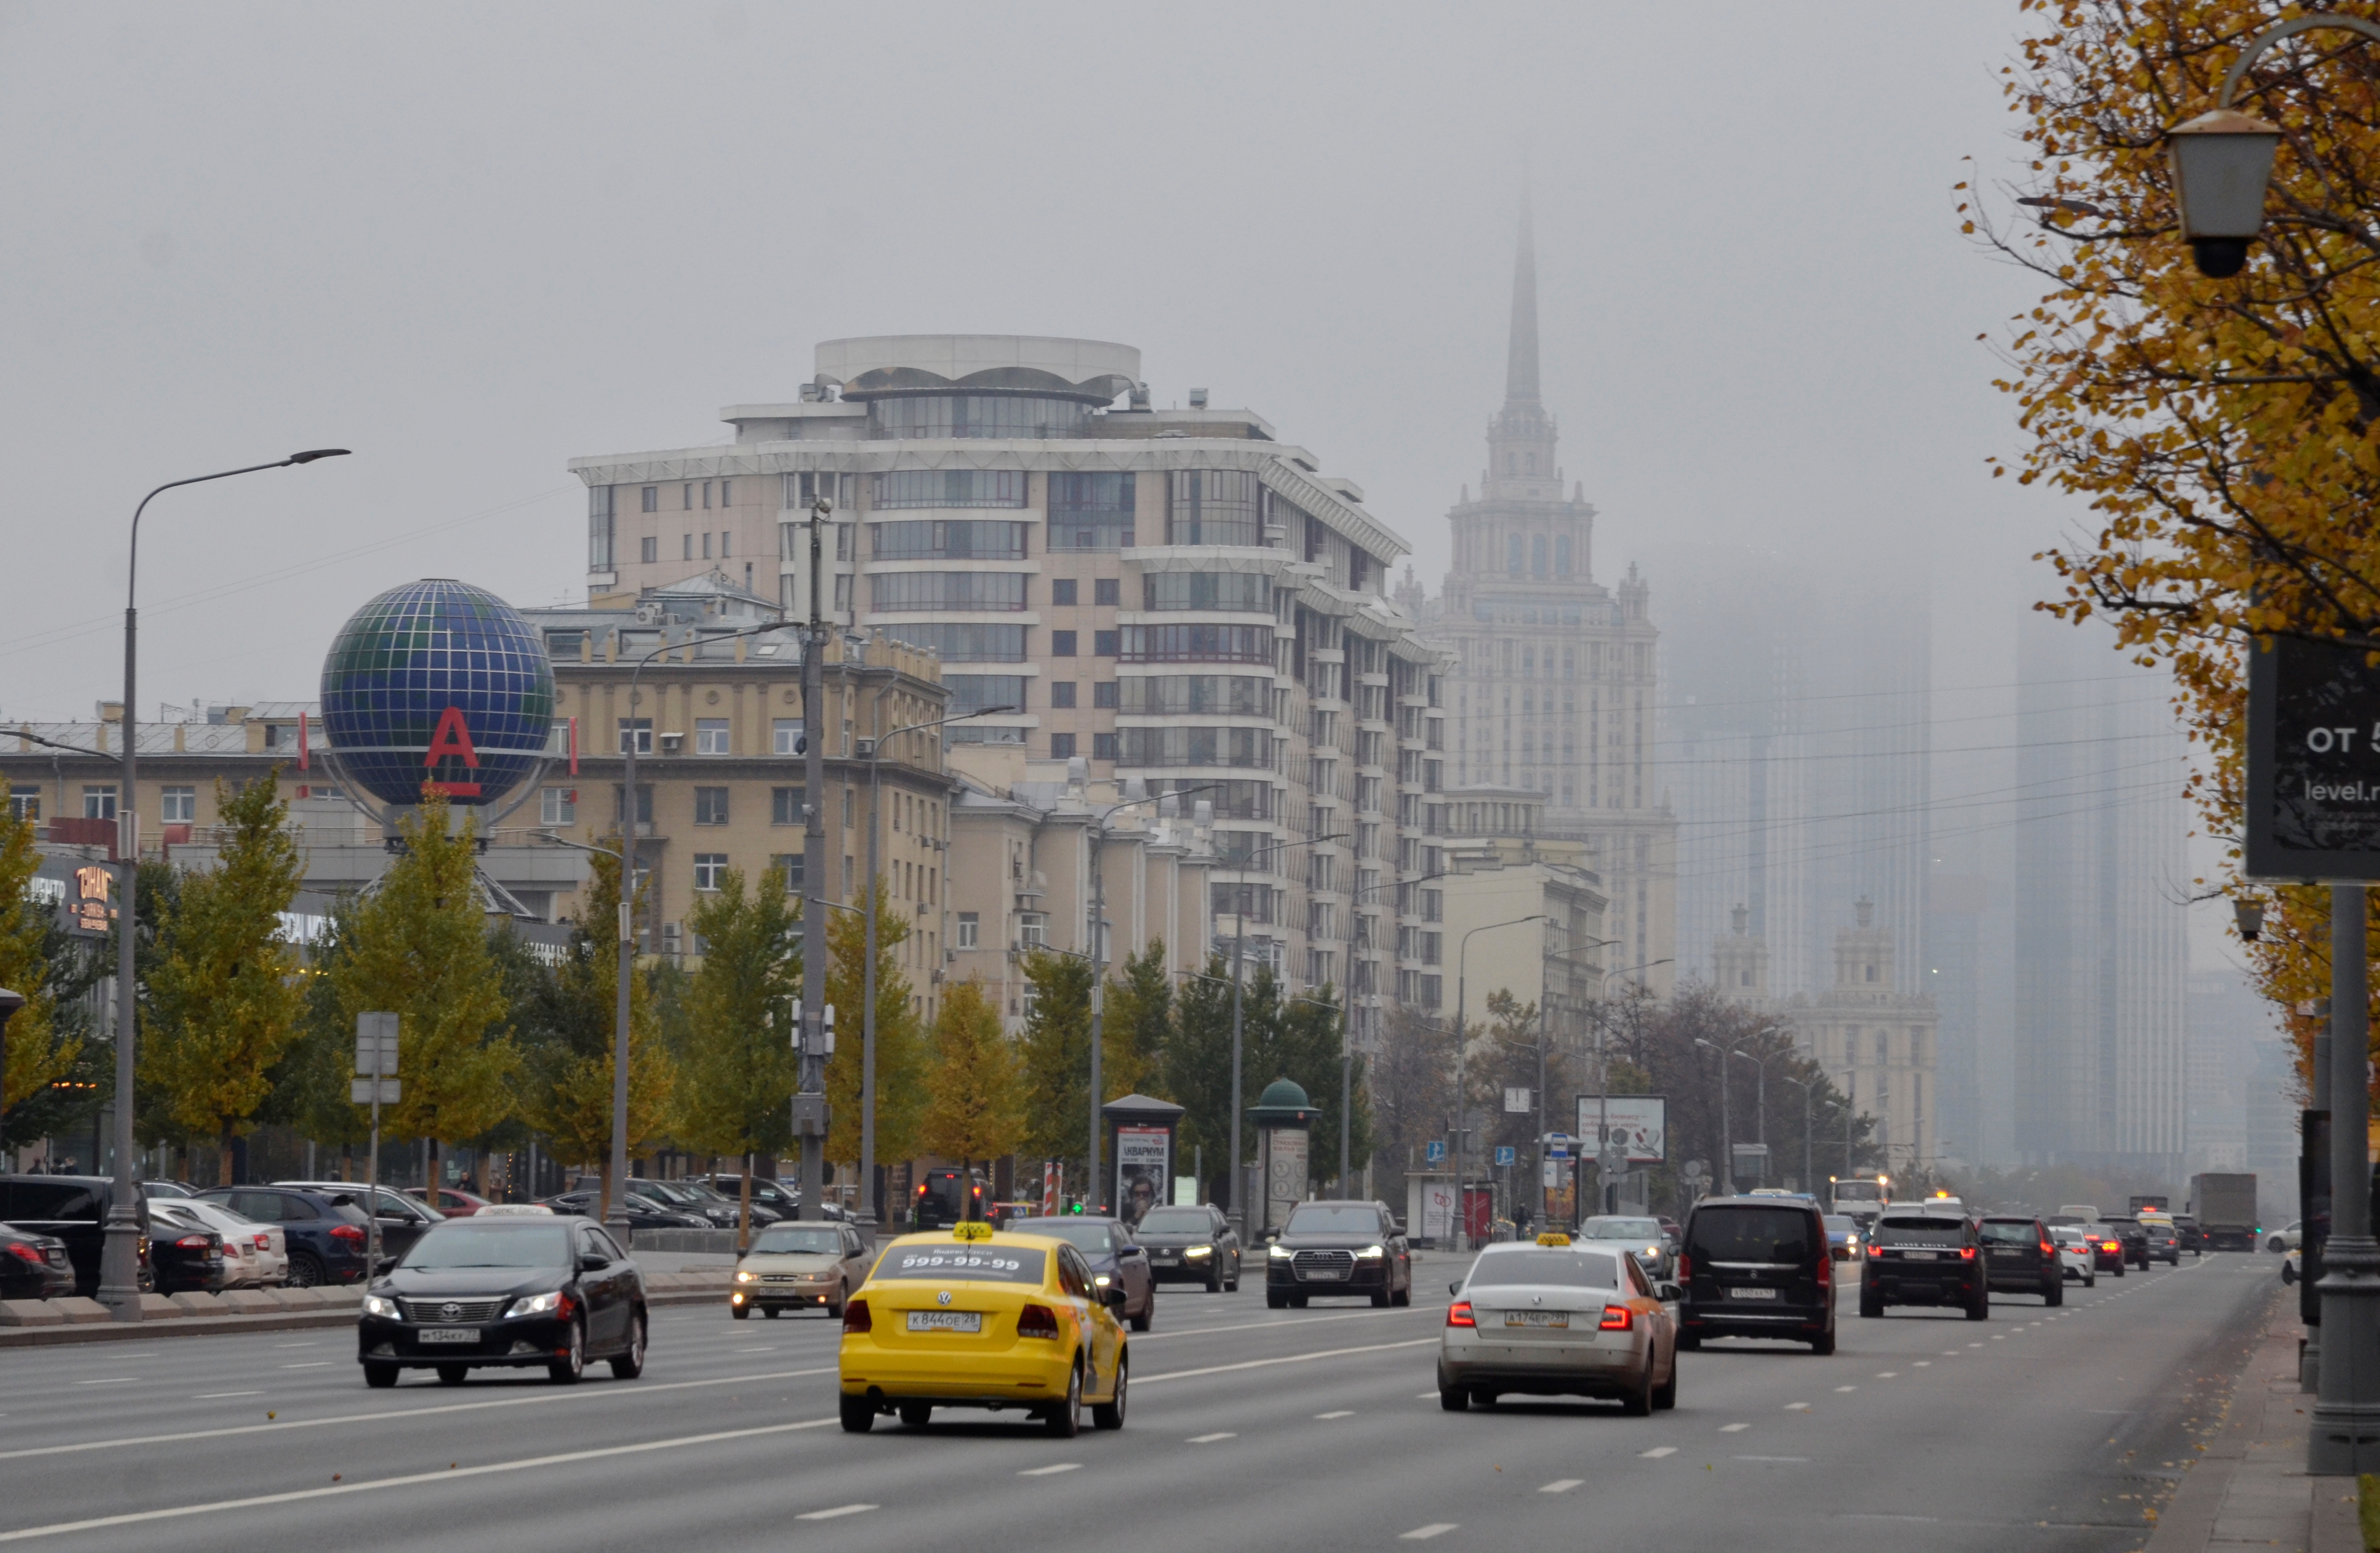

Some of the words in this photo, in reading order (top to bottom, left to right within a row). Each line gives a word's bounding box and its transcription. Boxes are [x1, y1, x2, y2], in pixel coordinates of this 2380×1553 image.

[1610, 1112, 1639, 1121] бизнесу
[1124, 1144, 1164, 1156] АКВАРИУМ
[902, 1256, 1020, 1270] 999-99-99
[912, 1314, 961, 1326] К844ОЕ
[964, 1314, 976, 1323] 28
